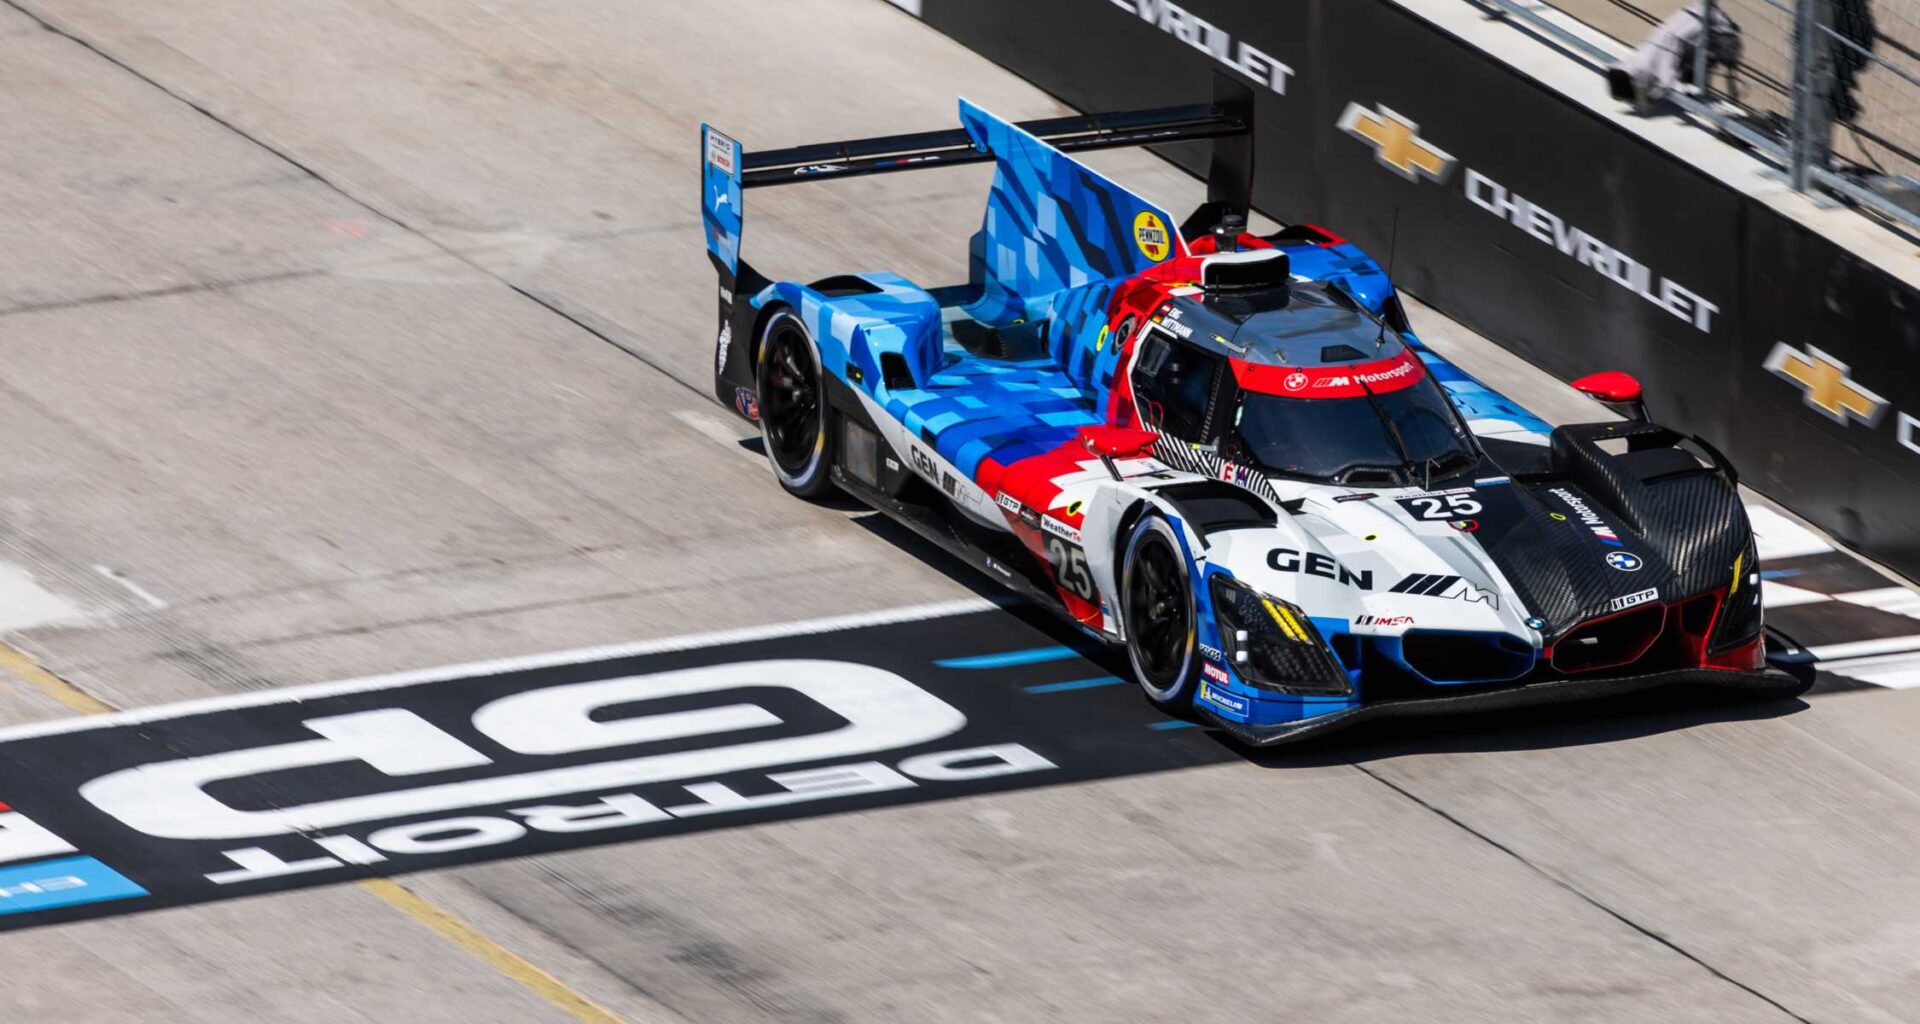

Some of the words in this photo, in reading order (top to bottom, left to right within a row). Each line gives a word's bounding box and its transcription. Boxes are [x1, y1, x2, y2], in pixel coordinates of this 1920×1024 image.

[1138, 227, 1165, 244] PENNZOIL
[1465, 167, 1719, 333] CHEVROLET
[1168, 307, 1184, 320] ENG
[1353, 362, 1413, 384] Motorsport
[911, 444, 940, 485] GEN
[1003, 497, 1019, 511] GTP
[1411, 493, 1482, 519] 25
[1548, 487, 1603, 525] Motorsport
[1050, 538, 1092, 600] 25
[1266, 548, 1373, 591] GEN
[1625, 590, 1656, 605] GTP
[1374, 615, 1415, 626] IMSA
[1203, 663, 1229, 685] MOTUL
[1211, 691, 1243, 711] MICHELIN
[79, 659, 967, 839] GP
[204, 742, 1058, 885] DETROIT
